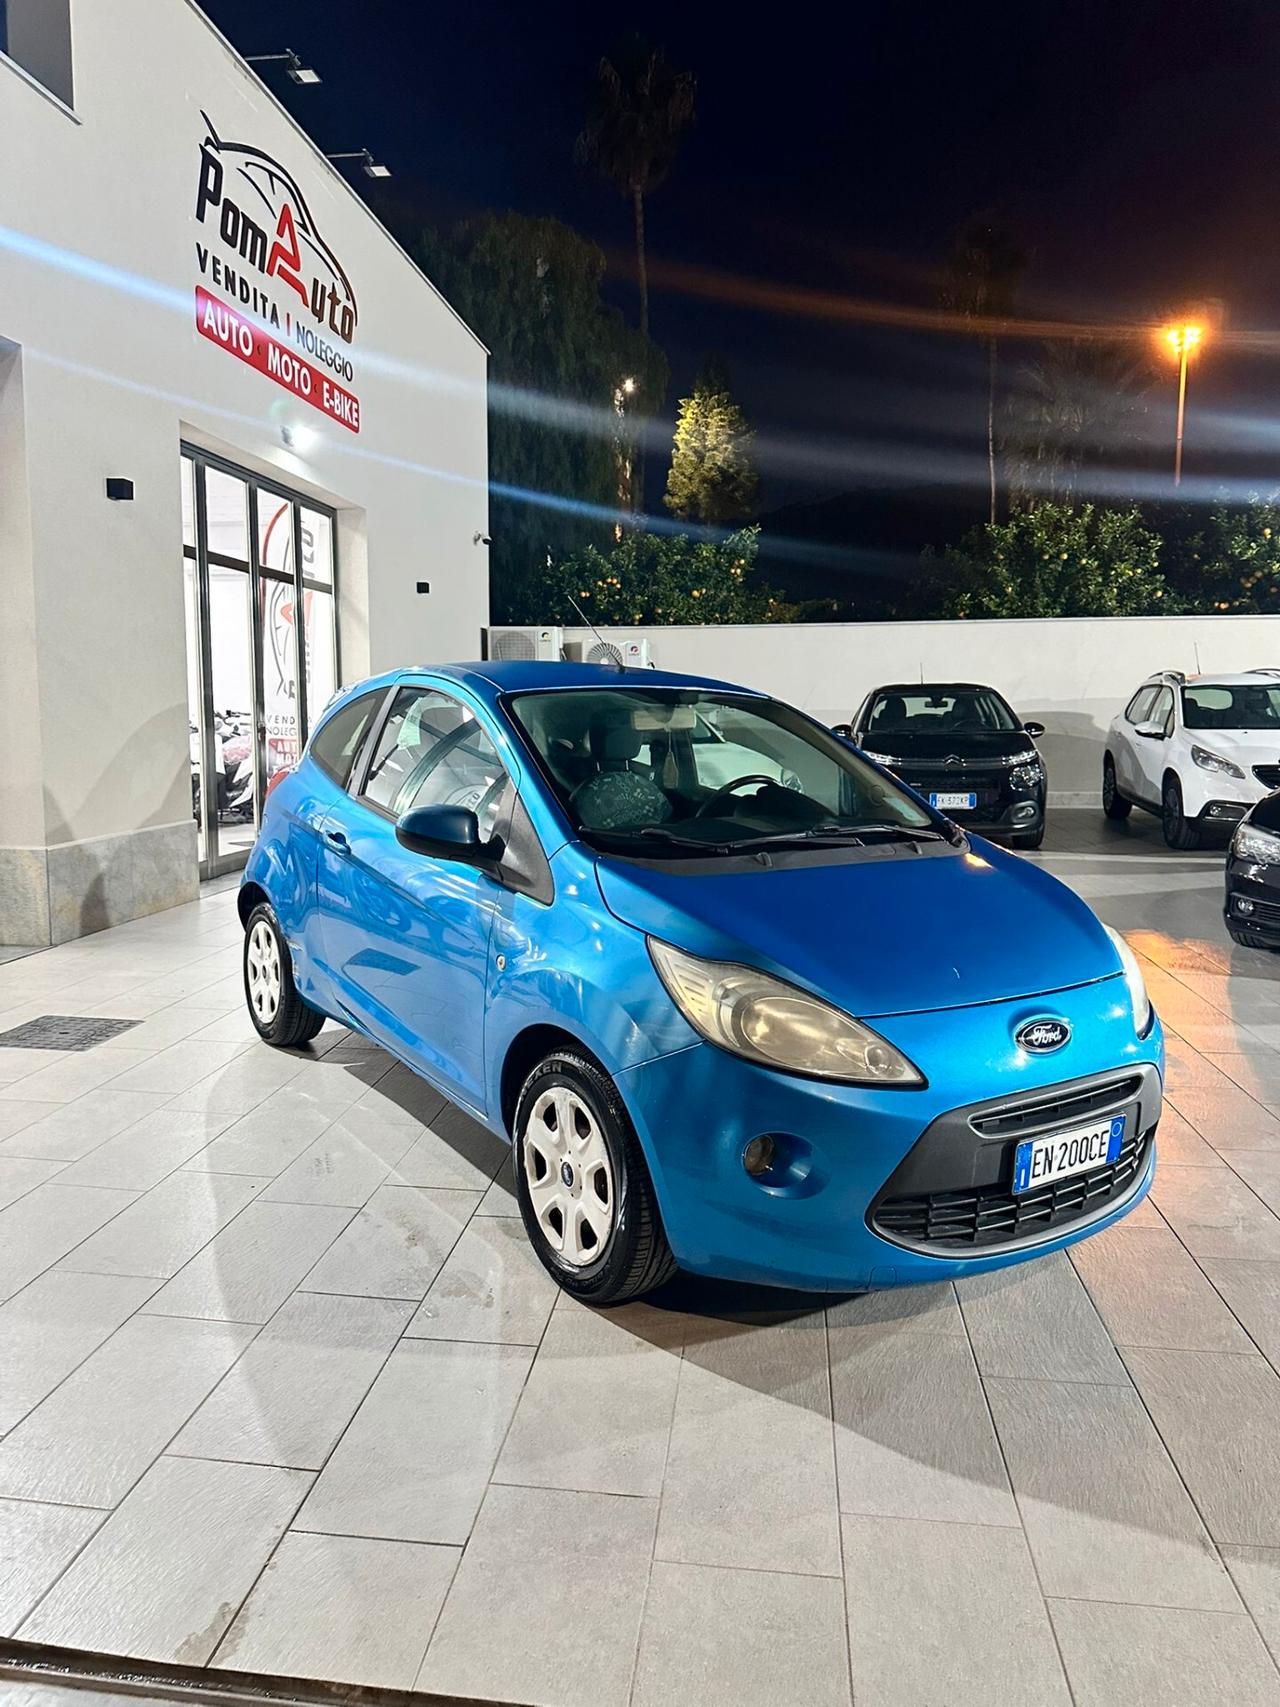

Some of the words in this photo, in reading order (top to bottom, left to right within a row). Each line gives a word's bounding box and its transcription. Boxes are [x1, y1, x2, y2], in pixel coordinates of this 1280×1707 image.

[196, 242, 280, 329] VENDITA
[296, 321, 353, 382] NOLEGGIO
[203, 302, 253, 357] AUTO
[267, 342, 311, 395] MOTO
[322, 380, 359, 428] E-BIKE
[266, 727, 296, 737] NOLEG
[277, 740, 297, 752] AUT
[1025, 1024, 1062, 1046] Ford
[1031, 1144, 1054, 1179] EN
[1057, 1129, 1110, 1169] 200CE
